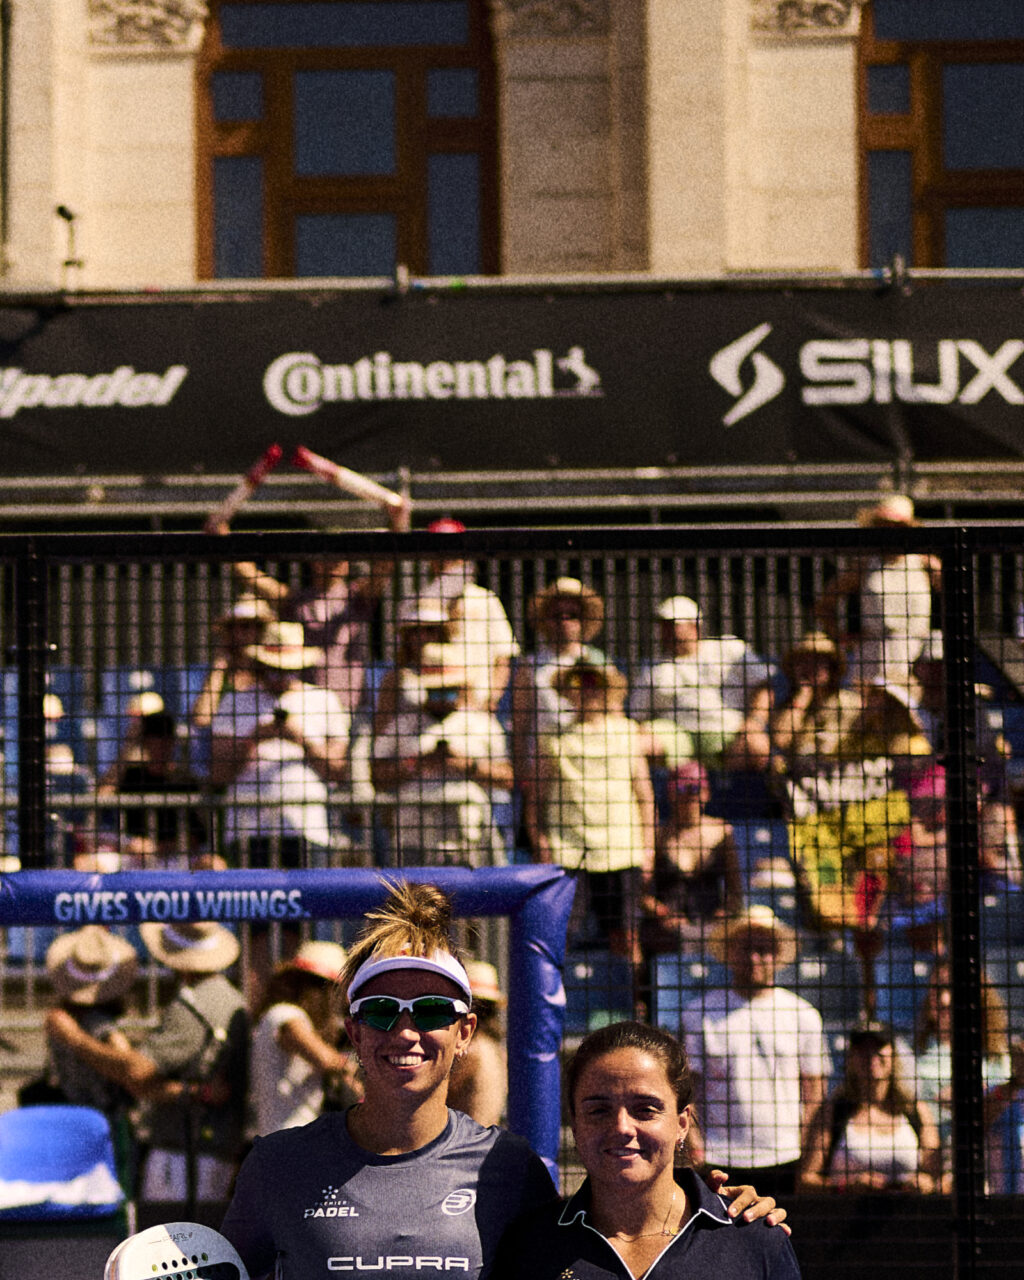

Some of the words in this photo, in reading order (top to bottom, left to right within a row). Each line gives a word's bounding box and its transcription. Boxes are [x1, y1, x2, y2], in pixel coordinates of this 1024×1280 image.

[263, 350, 553, 416] Continental
[799, 338, 1024, 405] SIUX
[54, 891, 127, 921] GIVES
[134, 890, 190, 920] YOU
[304, 1206, 360, 1218] PADEL
[327, 1256, 469, 1272] CUPRA
